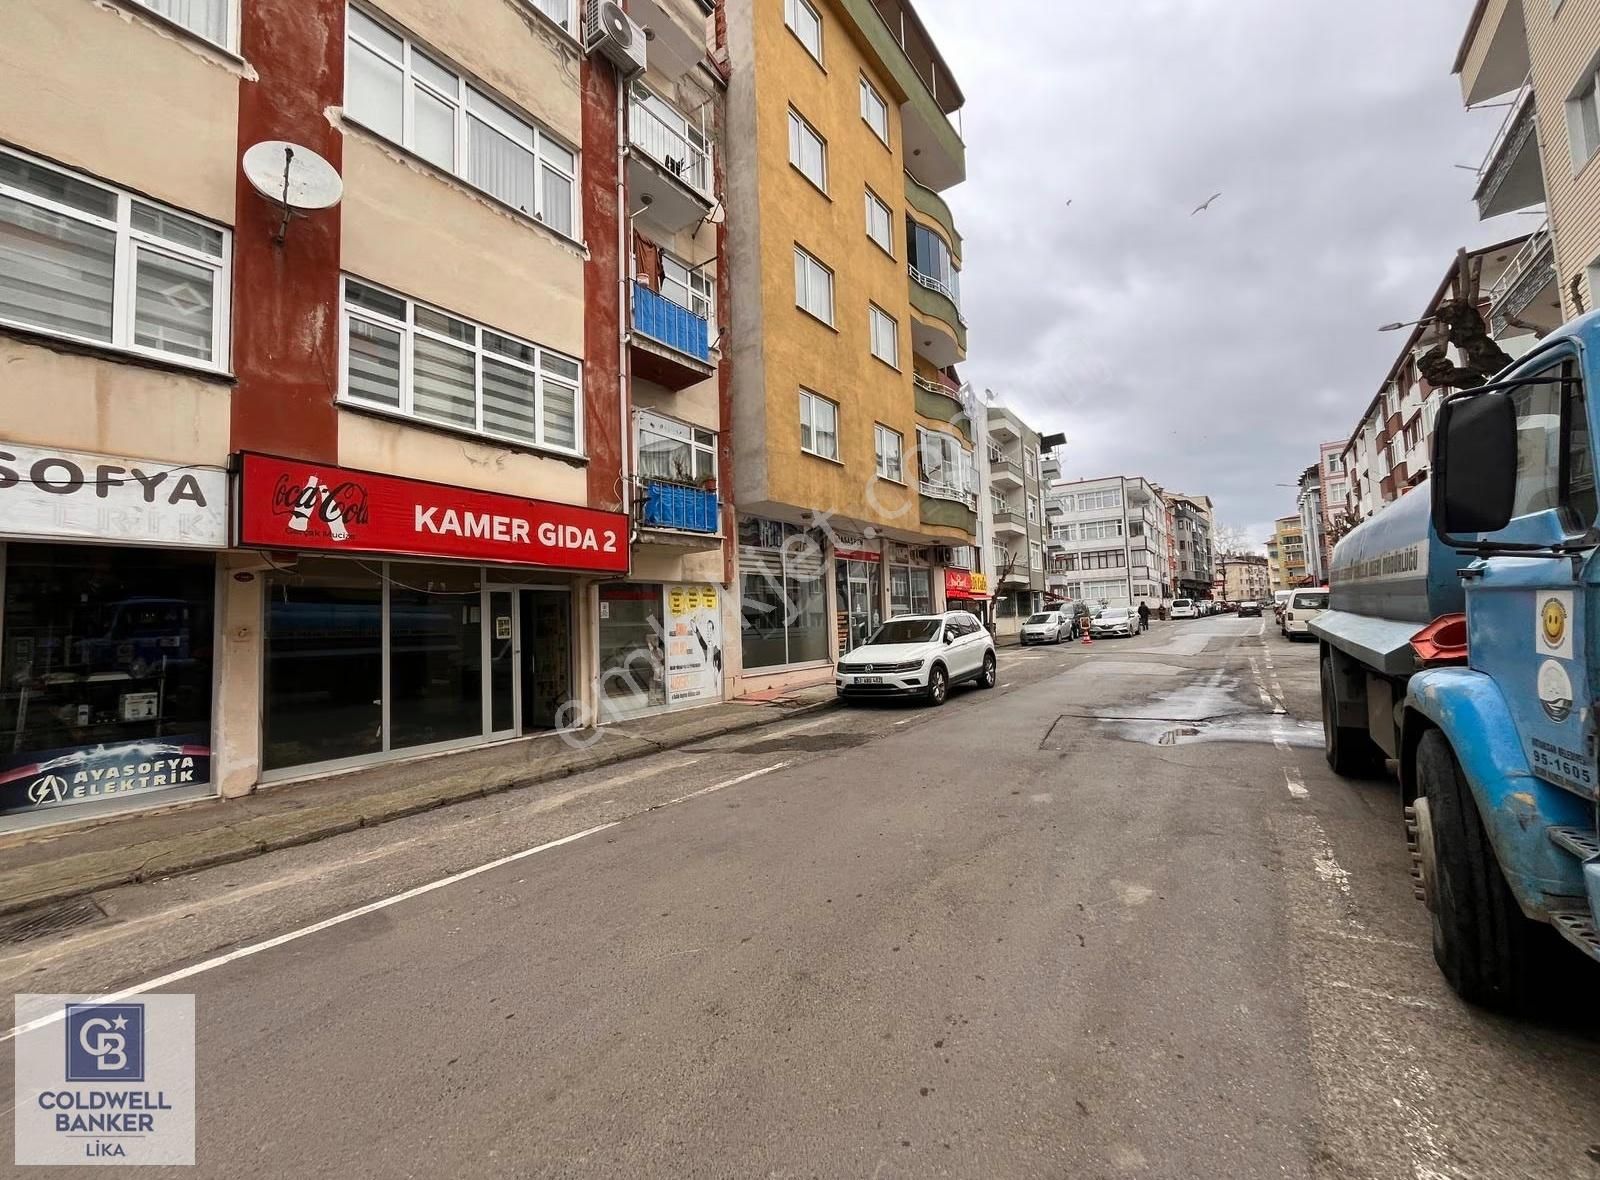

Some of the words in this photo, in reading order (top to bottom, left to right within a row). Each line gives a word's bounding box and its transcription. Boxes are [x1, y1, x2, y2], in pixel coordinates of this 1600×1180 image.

[415, 504, 531, 544] KAMER
[537, 522, 599, 551] GIDA
[603, 530, 617, 553] 2
[72, 756, 195, 784] AYASOFYA
[1533, 750, 1591, 784] 95-1605
[73, 770, 194, 798] ELEKTRİK
